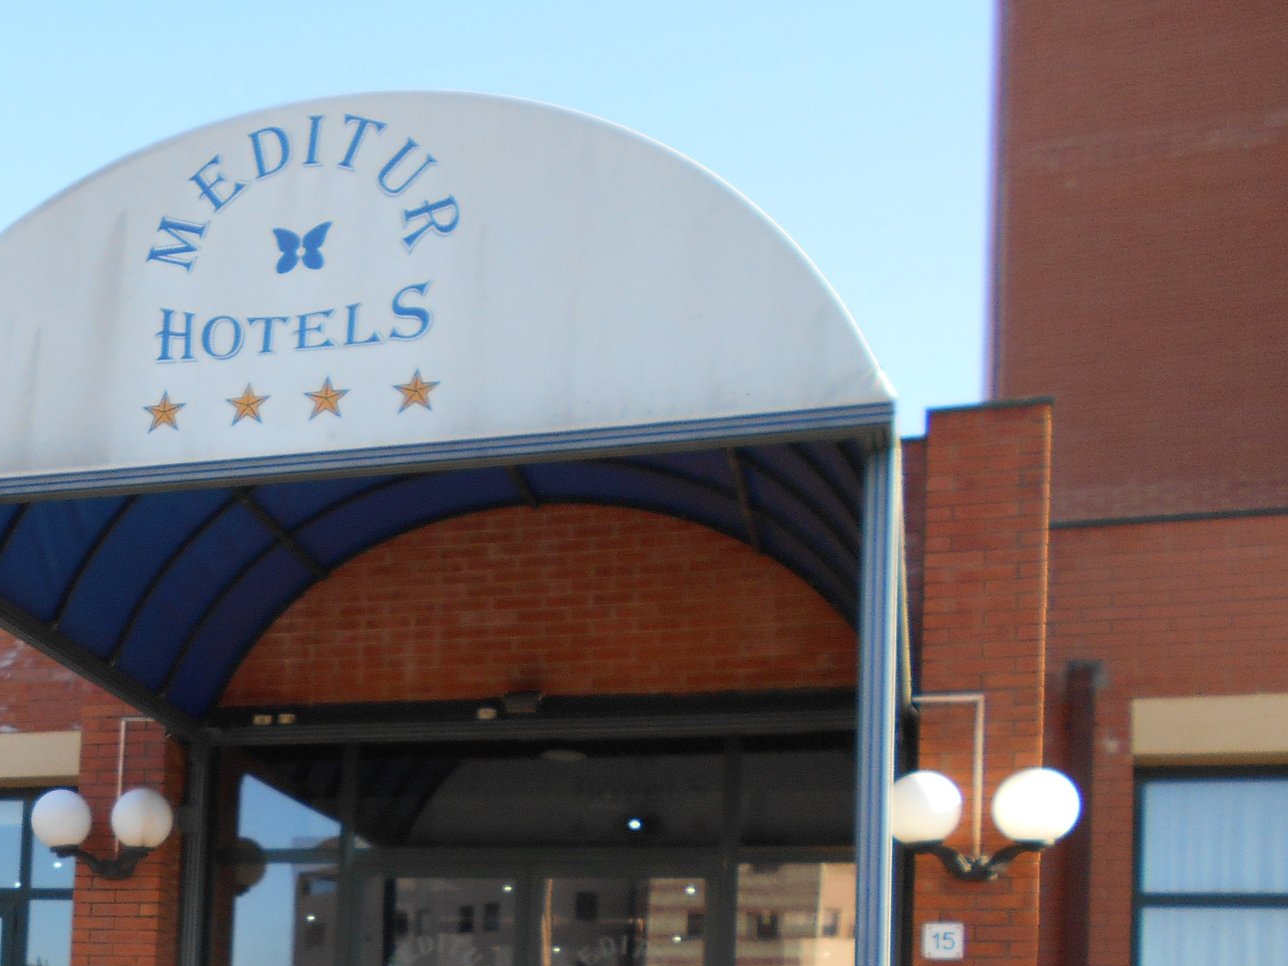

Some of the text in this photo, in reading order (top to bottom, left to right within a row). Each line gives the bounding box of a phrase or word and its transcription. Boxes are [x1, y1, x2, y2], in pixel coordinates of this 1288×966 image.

[146, 113, 461, 273] MEDITUR
[154, 280, 433, 361] HOTELS
[931, 931, 957, 951] 15
